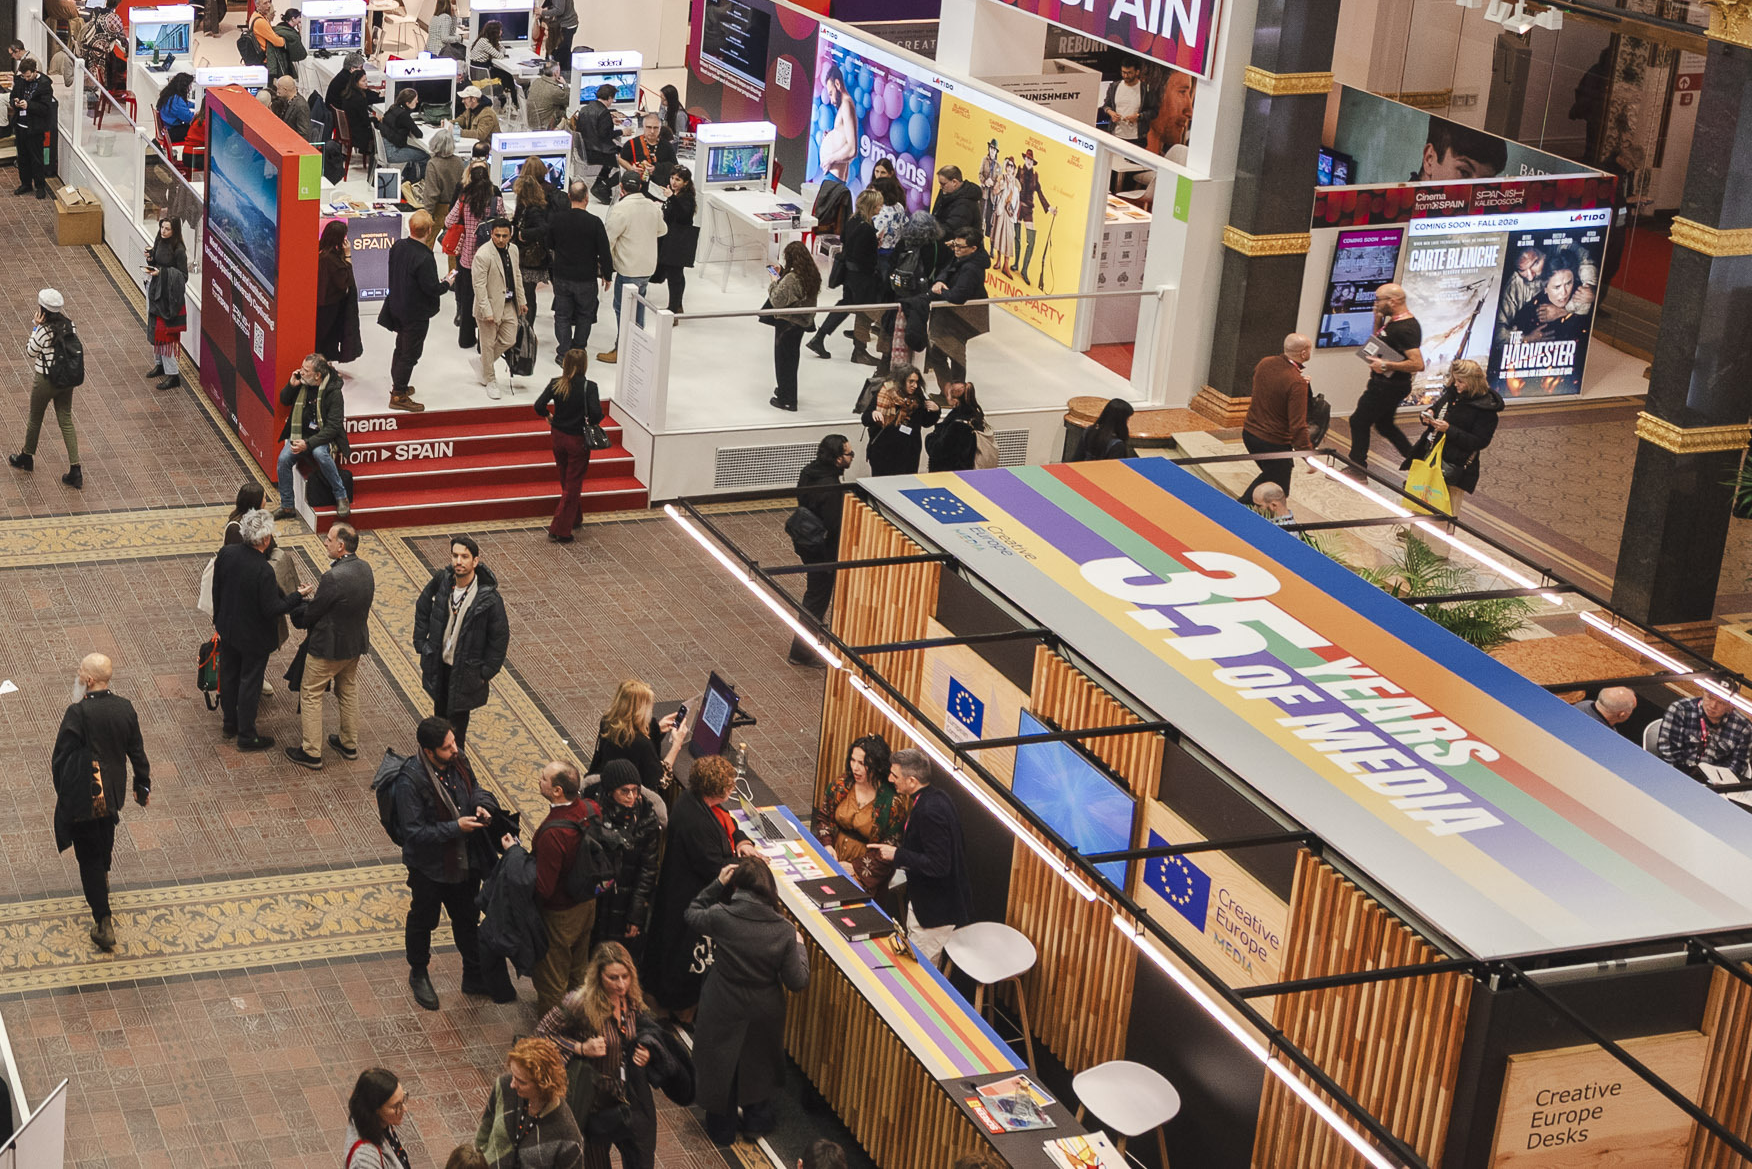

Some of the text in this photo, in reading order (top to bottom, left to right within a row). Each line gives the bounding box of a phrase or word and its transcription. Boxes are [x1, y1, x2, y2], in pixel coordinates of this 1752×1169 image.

[597, 58, 623, 68] sideral
[1415, 200, 1464, 211] from SPAIN
[1416, 192, 1446, 202] Cinema
[1474, 197, 1523, 207] KALEIDOSCOPE
[1476, 189, 1525, 199] SPANISH
[1414, 218, 1519, 231] COMING SOON FALL 2026
[353, 237, 395, 250] SPAIN
[1409, 246, 1500, 272] CARTE BLANCHE
[1510, 331, 1523, 343] THE
[1500, 340, 1576, 370] HARVESTER
[395, 442, 454, 461] SPAIN
[969, 526, 1013, 556] Europe
[988, 525, 1037, 560] Creative
[1079, 548, 1334, 670] 35
[1314, 655, 1502, 774] YEARS
[1210, 653, 1508, 840] OF MEDIA
[1217, 887, 1283, 953] Creative
[1215, 909, 1269, 964] Europe
[1212, 933, 1254, 976] MEDIA
[1535, 1079, 1623, 1109] Creative
[1528, 1101, 1604, 1136] Europe
[1525, 1125, 1590, 1151] Desks
